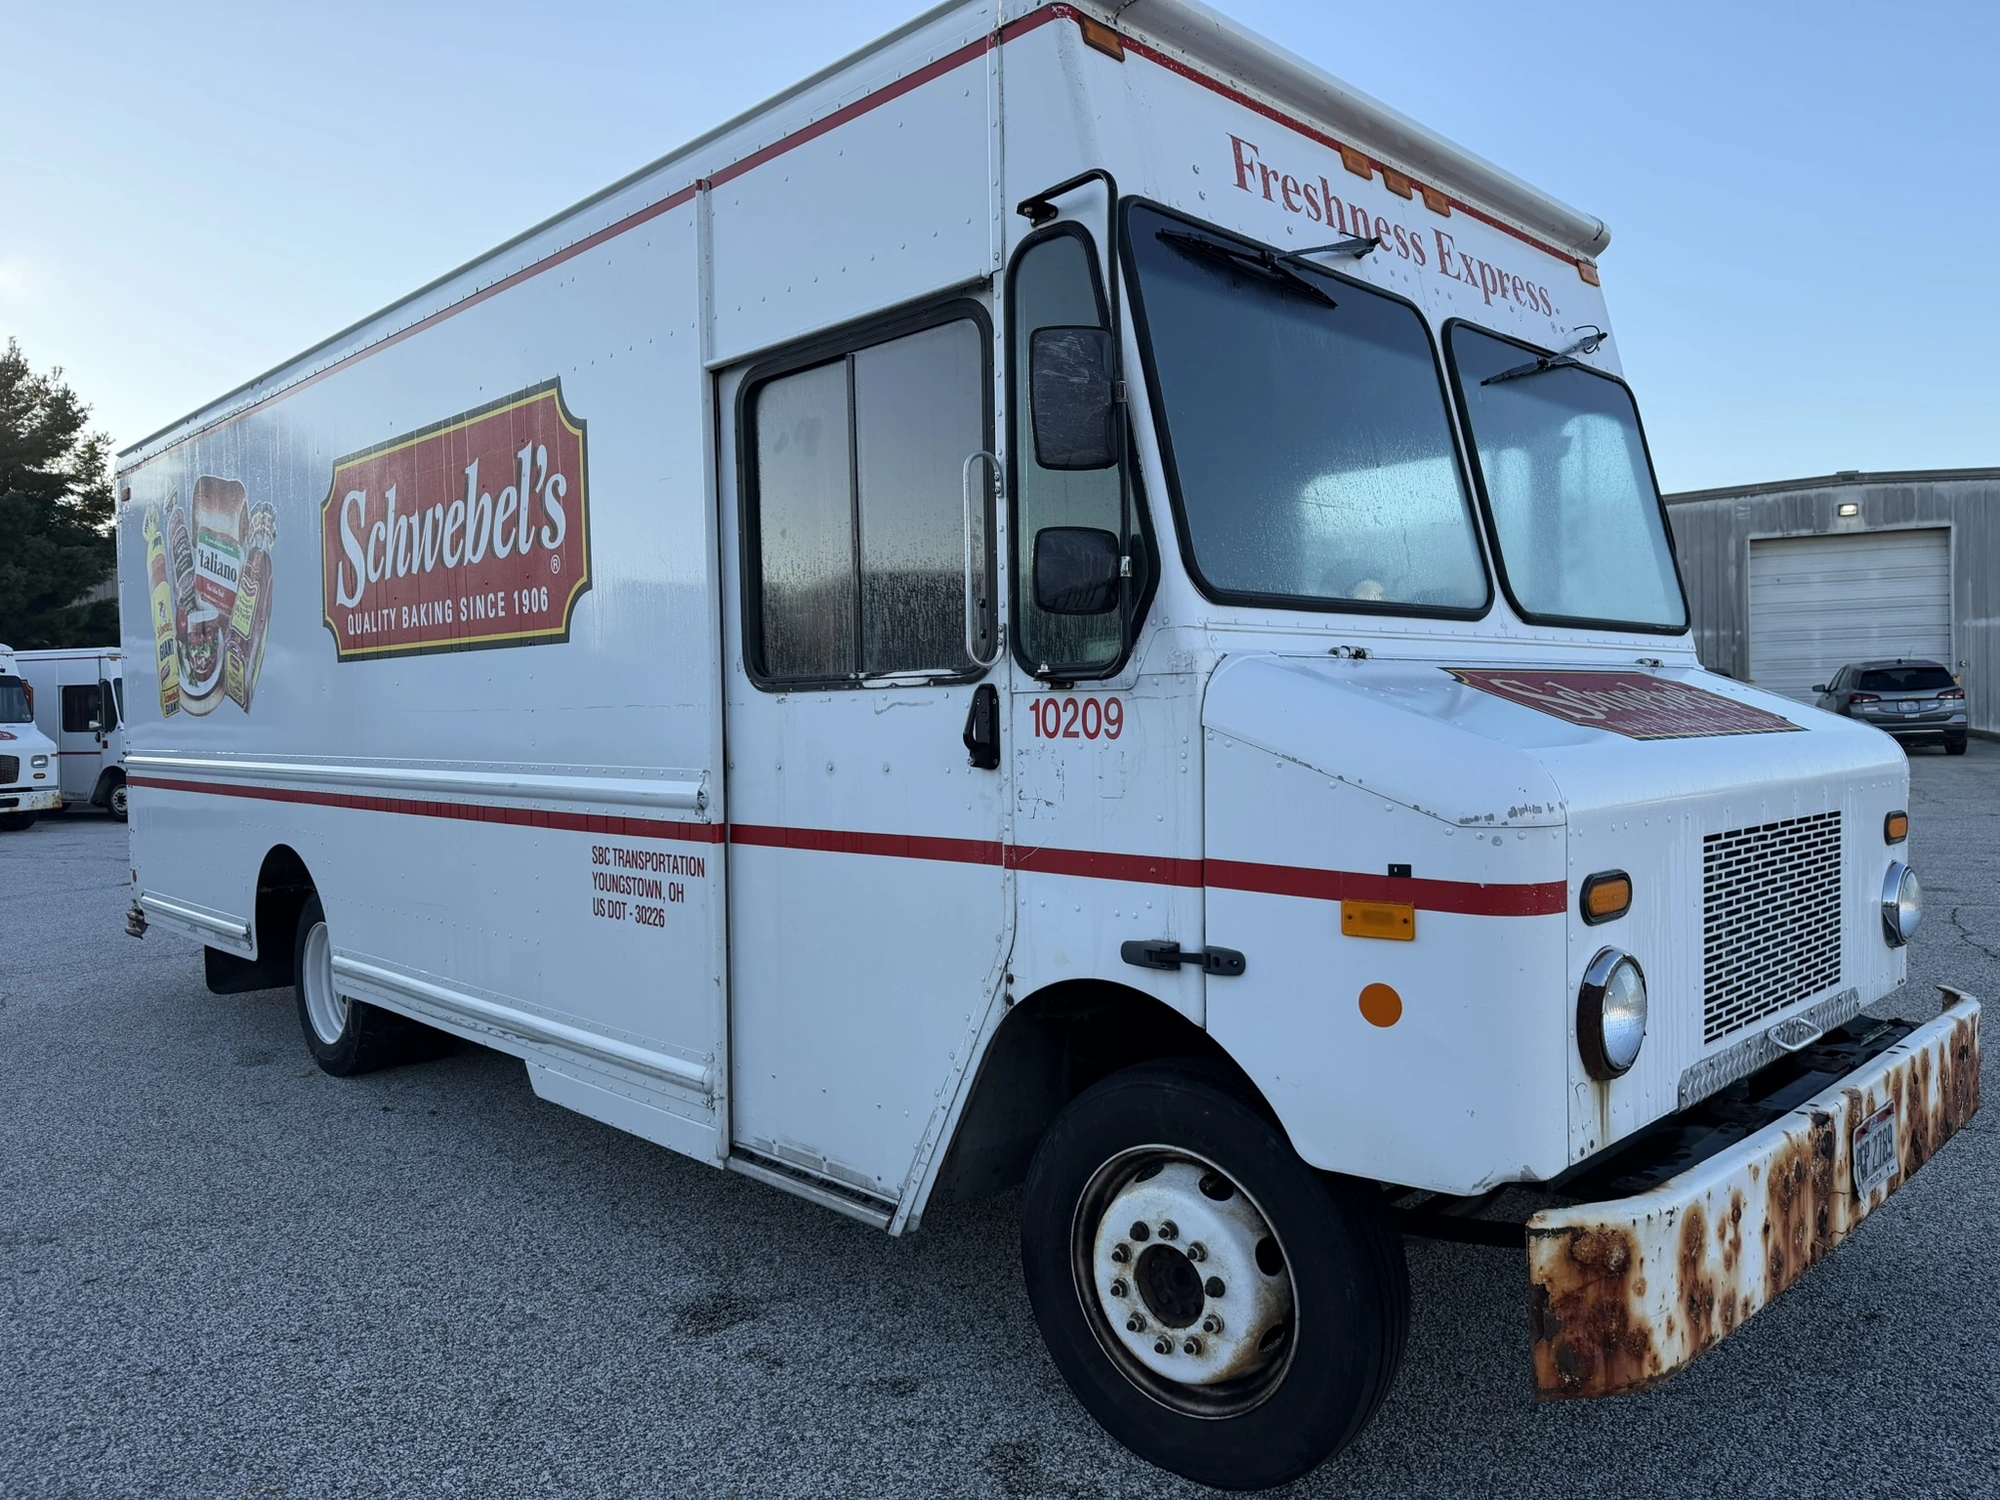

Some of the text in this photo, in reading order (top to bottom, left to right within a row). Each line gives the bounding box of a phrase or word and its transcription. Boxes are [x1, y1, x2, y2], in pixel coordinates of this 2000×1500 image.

[1226, 132, 1553, 317] Freshness Express
[336, 440, 568, 608] Schwebel's
[347, 586, 549, 635] QUALITY BAKING SINCE 1906
[1029, 697, 1124, 740] 10209
[592, 845, 705, 878] SBC TRANSPORTATION
[592, 871, 684, 904] YOUNGSTOWN, OH
[593, 897, 606, 917] US
[608, 900, 627, 921] DOT
[635, 904, 665, 928] 30226
[1872, 1124, 1893, 1170] 2789
